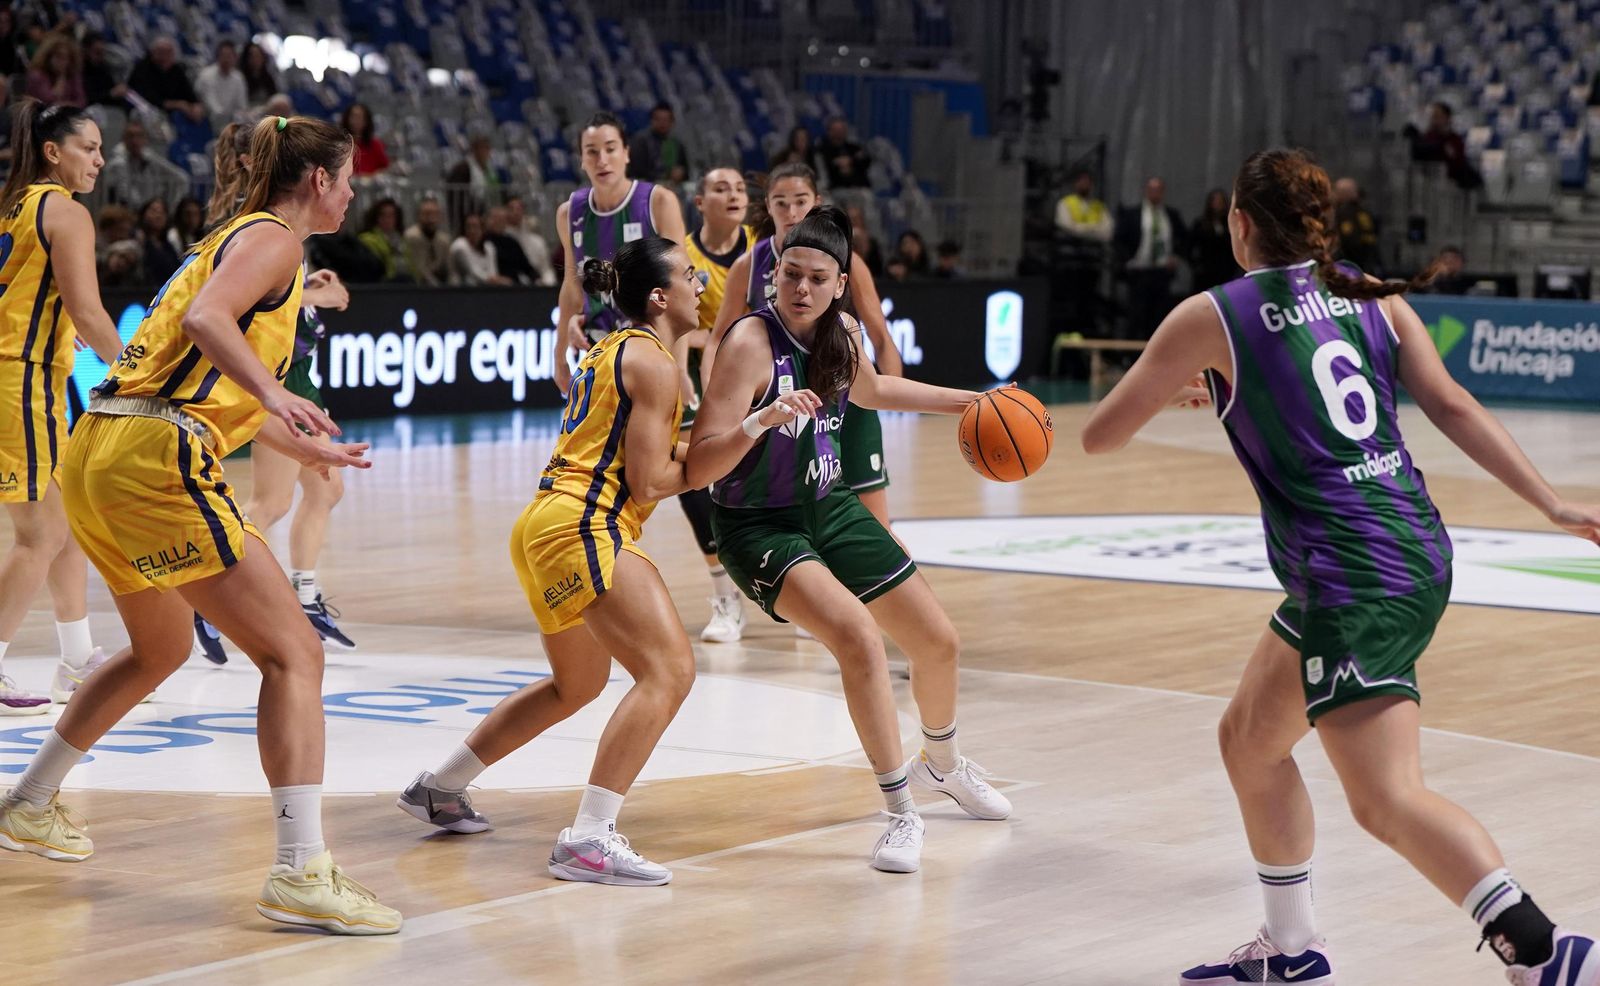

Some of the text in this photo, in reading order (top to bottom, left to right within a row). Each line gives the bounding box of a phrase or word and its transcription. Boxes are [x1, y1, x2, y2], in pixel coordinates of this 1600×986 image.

[1471, 319, 1600, 352] Fundació
[329, 308, 467, 409] mejor
[1469, 346, 1575, 384] Unicaja
[1311, 339, 1379, 441] 6
[169, 556, 204, 574] DEPORTE
